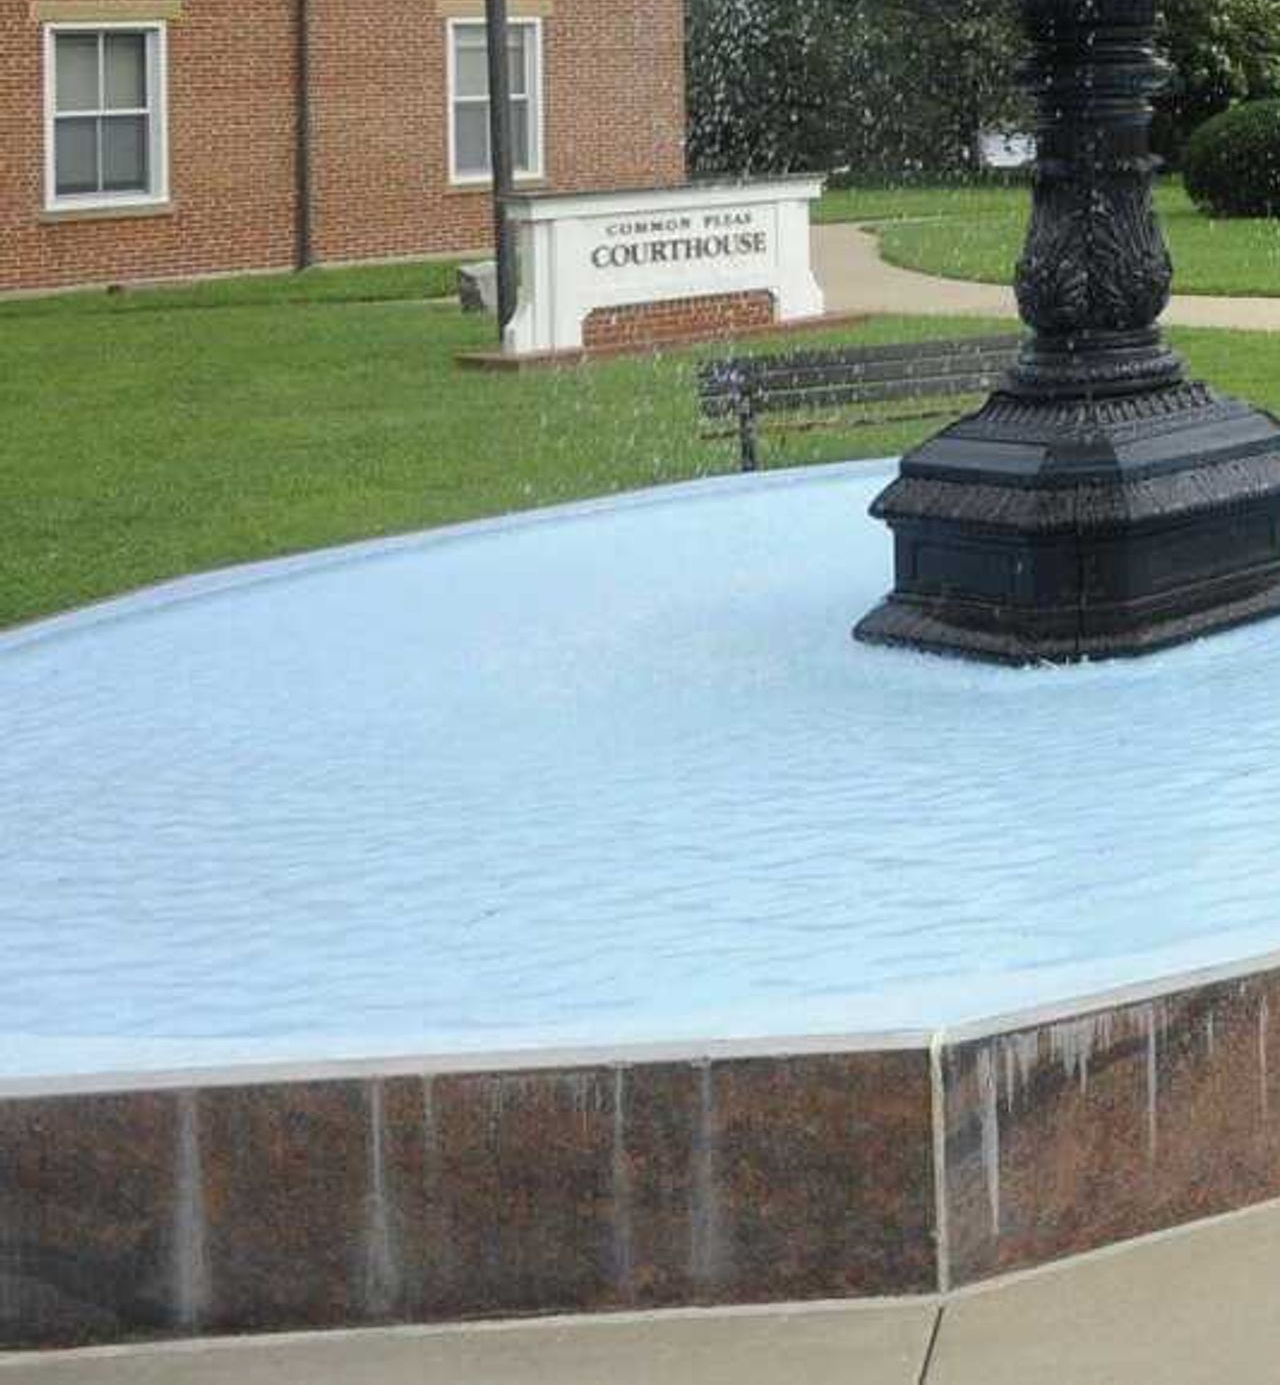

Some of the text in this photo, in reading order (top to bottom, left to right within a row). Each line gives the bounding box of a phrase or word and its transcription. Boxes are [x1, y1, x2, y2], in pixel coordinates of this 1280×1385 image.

[606, 212, 752, 236] COMMON PLEAS
[592, 232, 766, 268] COURTHOUSE
